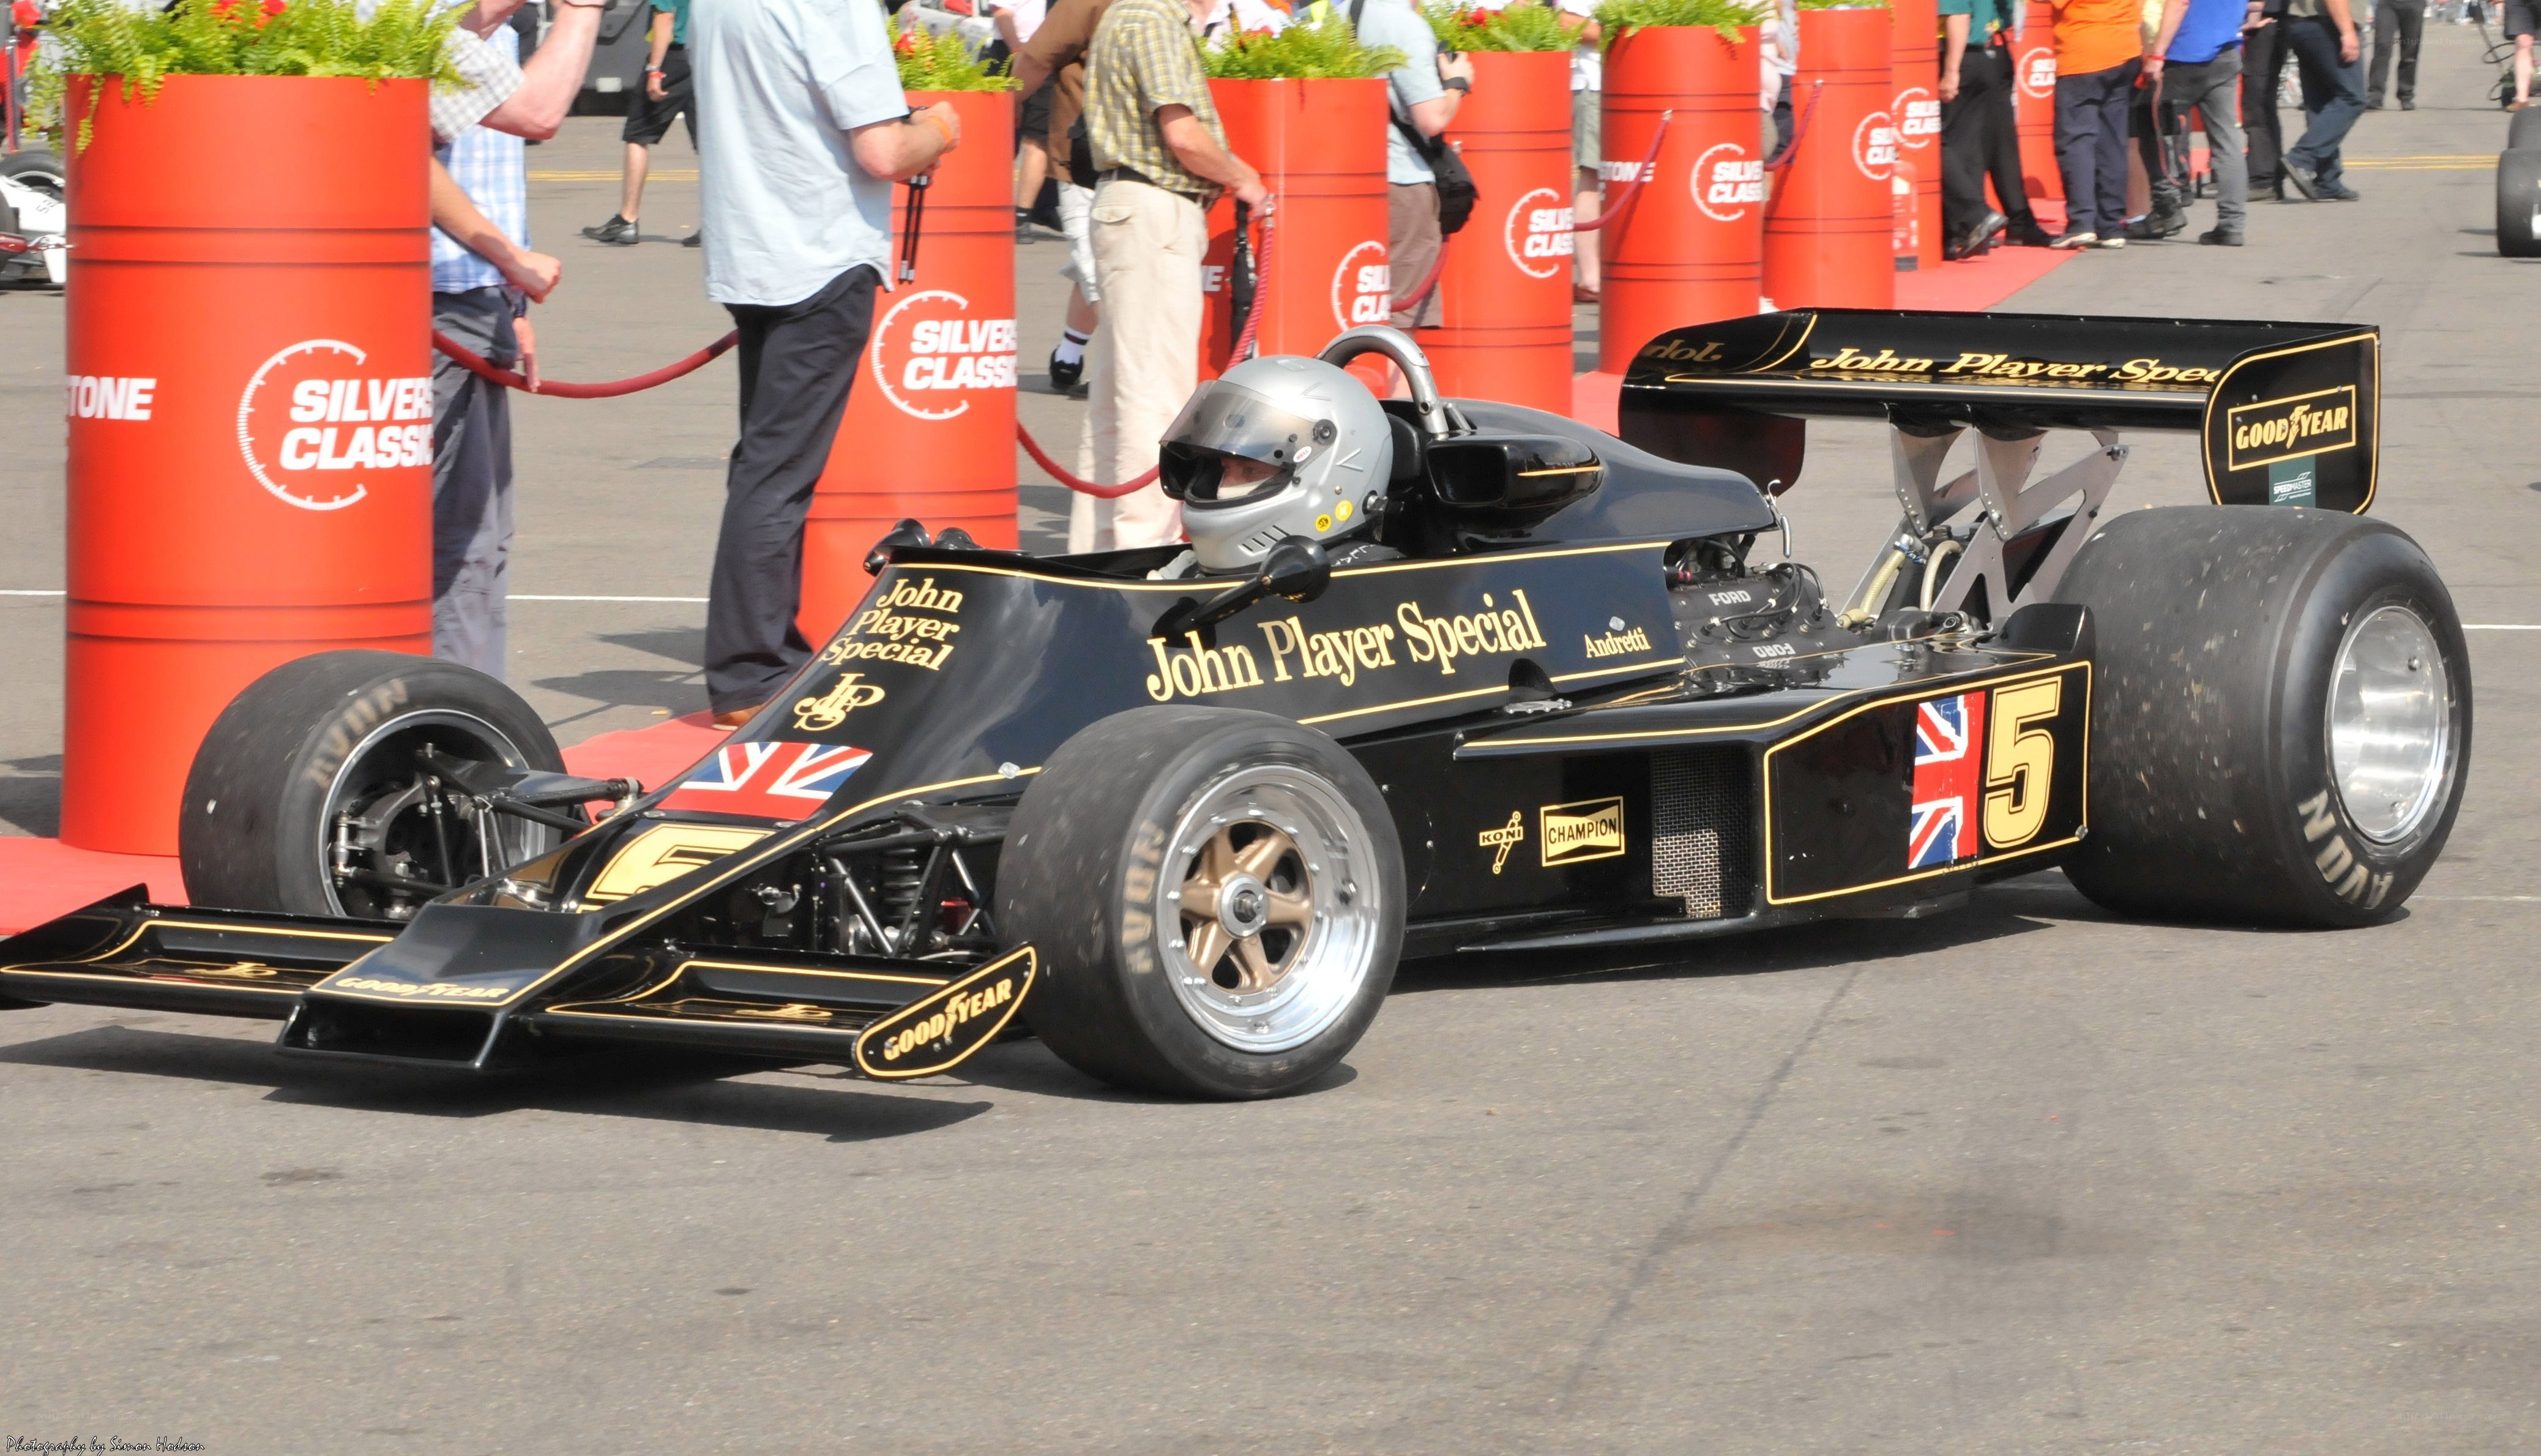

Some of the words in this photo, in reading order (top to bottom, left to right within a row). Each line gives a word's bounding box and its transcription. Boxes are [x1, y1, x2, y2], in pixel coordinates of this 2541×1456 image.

[1810, 348, 1933, 371] John
[1938, 353, 2107, 378] Player
[2236, 404, 2348, 449] GOODYEAR
[876, 578, 963, 613] John
[1708, 590, 1752, 605] FORD
[846, 608, 960, 641] Player
[818, 637, 954, 671] Special
[1146, 630, 1264, 701] John
[1257, 616, 1395, 687] Player
[1397, 589, 1547, 674] Special
[1584, 627, 1651, 658] Andretti
[1752, 643, 1796, 658] FORD
[1983, 676, 2062, 848] 5
[1482, 829, 1521, 843] KONI
[1548, 818, 1617, 845] CHAMPION
[2297, 788, 2394, 910] AVON
[336, 978, 509, 997] GOODYEAR
[884, 979, 1012, 1060] GOODYEAR
